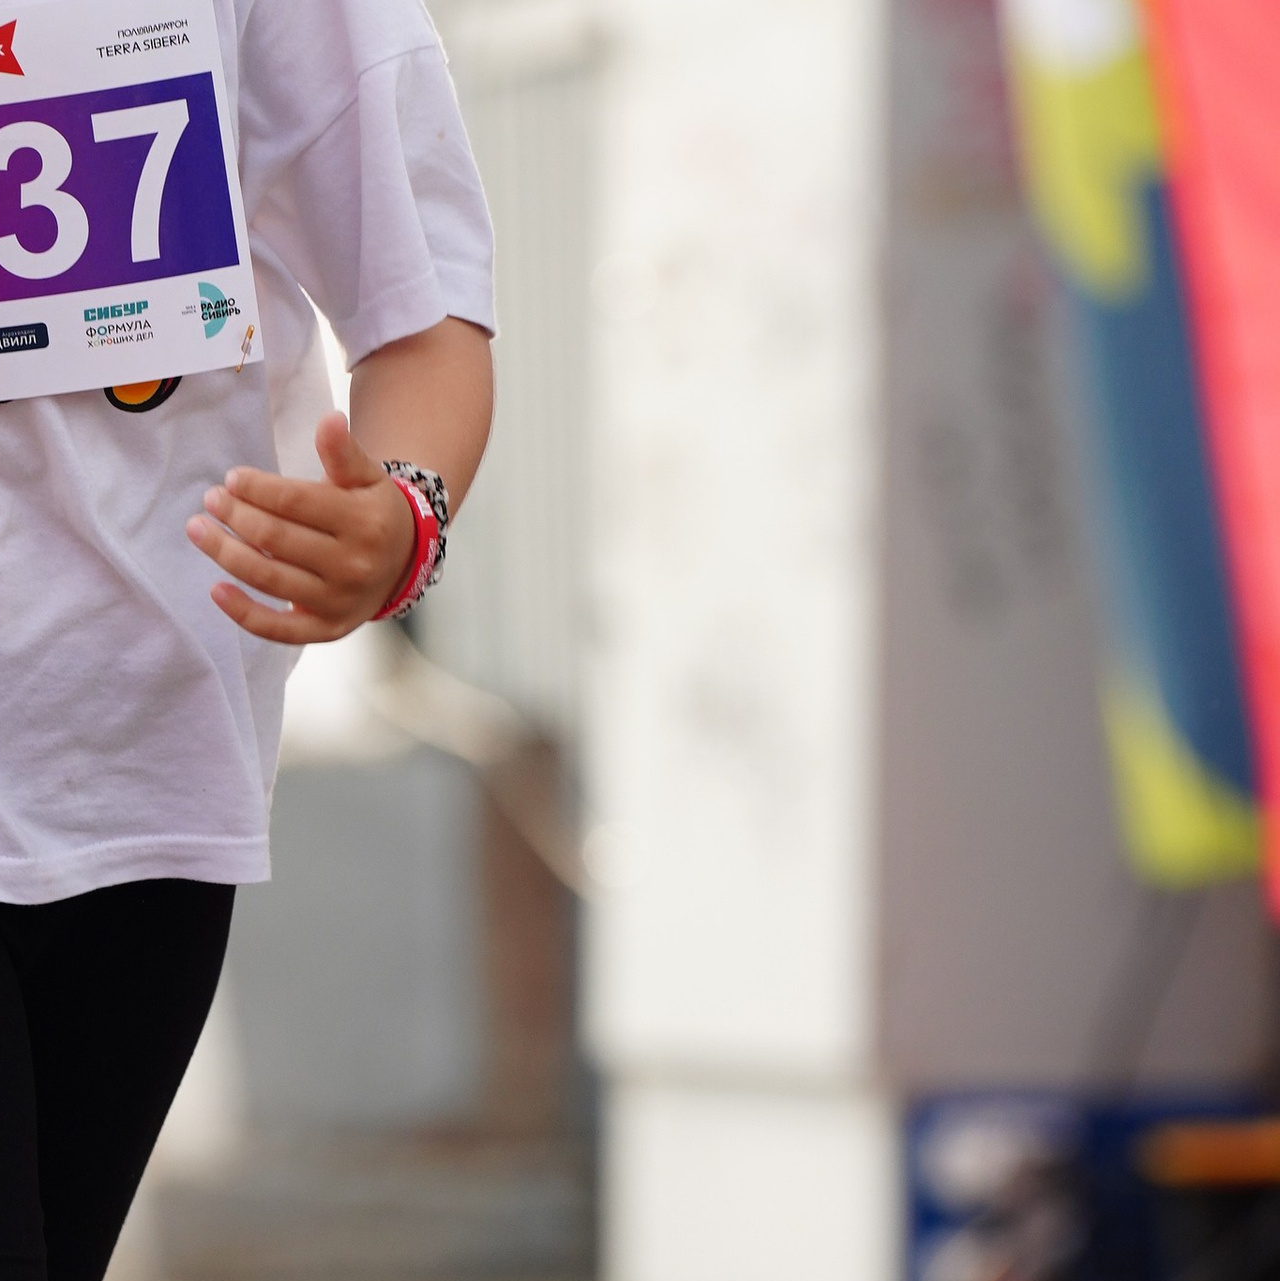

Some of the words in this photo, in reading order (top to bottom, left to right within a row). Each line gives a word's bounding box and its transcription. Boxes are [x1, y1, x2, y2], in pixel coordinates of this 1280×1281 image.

[96, 41, 141, 59] TERRA
[143, 33, 190, 51] SIBERIA
[84, 300, 148, 322] СИБУР
[200, 297, 236, 312] РАДИО
[201, 307, 241, 321] СИБИРЬ
[86, 319, 152, 338] ФОРМУЛА
[87, 334, 134, 348] ХОРОШИХ
[136, 331, 154, 342] ДЕЛ
